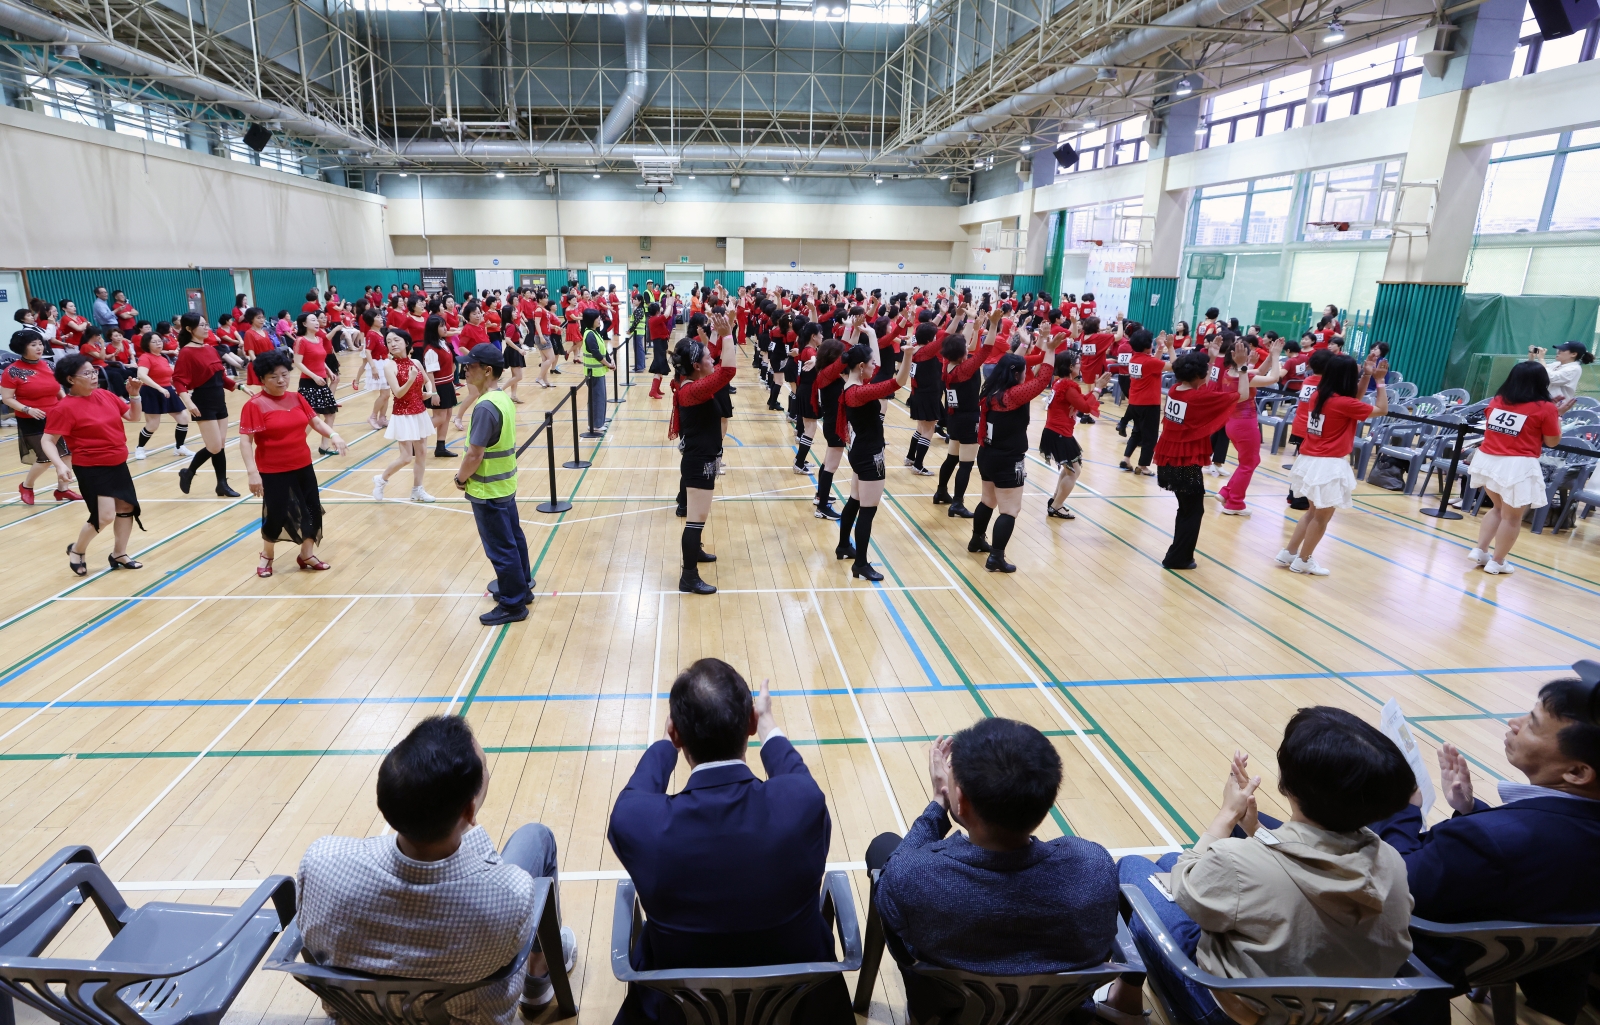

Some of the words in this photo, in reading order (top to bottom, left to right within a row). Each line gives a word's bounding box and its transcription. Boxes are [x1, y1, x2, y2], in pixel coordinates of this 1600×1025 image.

[1120, 354, 1129, 362] 37
[1130, 364, 1139, 374] 39
[1167, 400, 1180, 416] 40
[1495, 412, 1518, 427] 45
